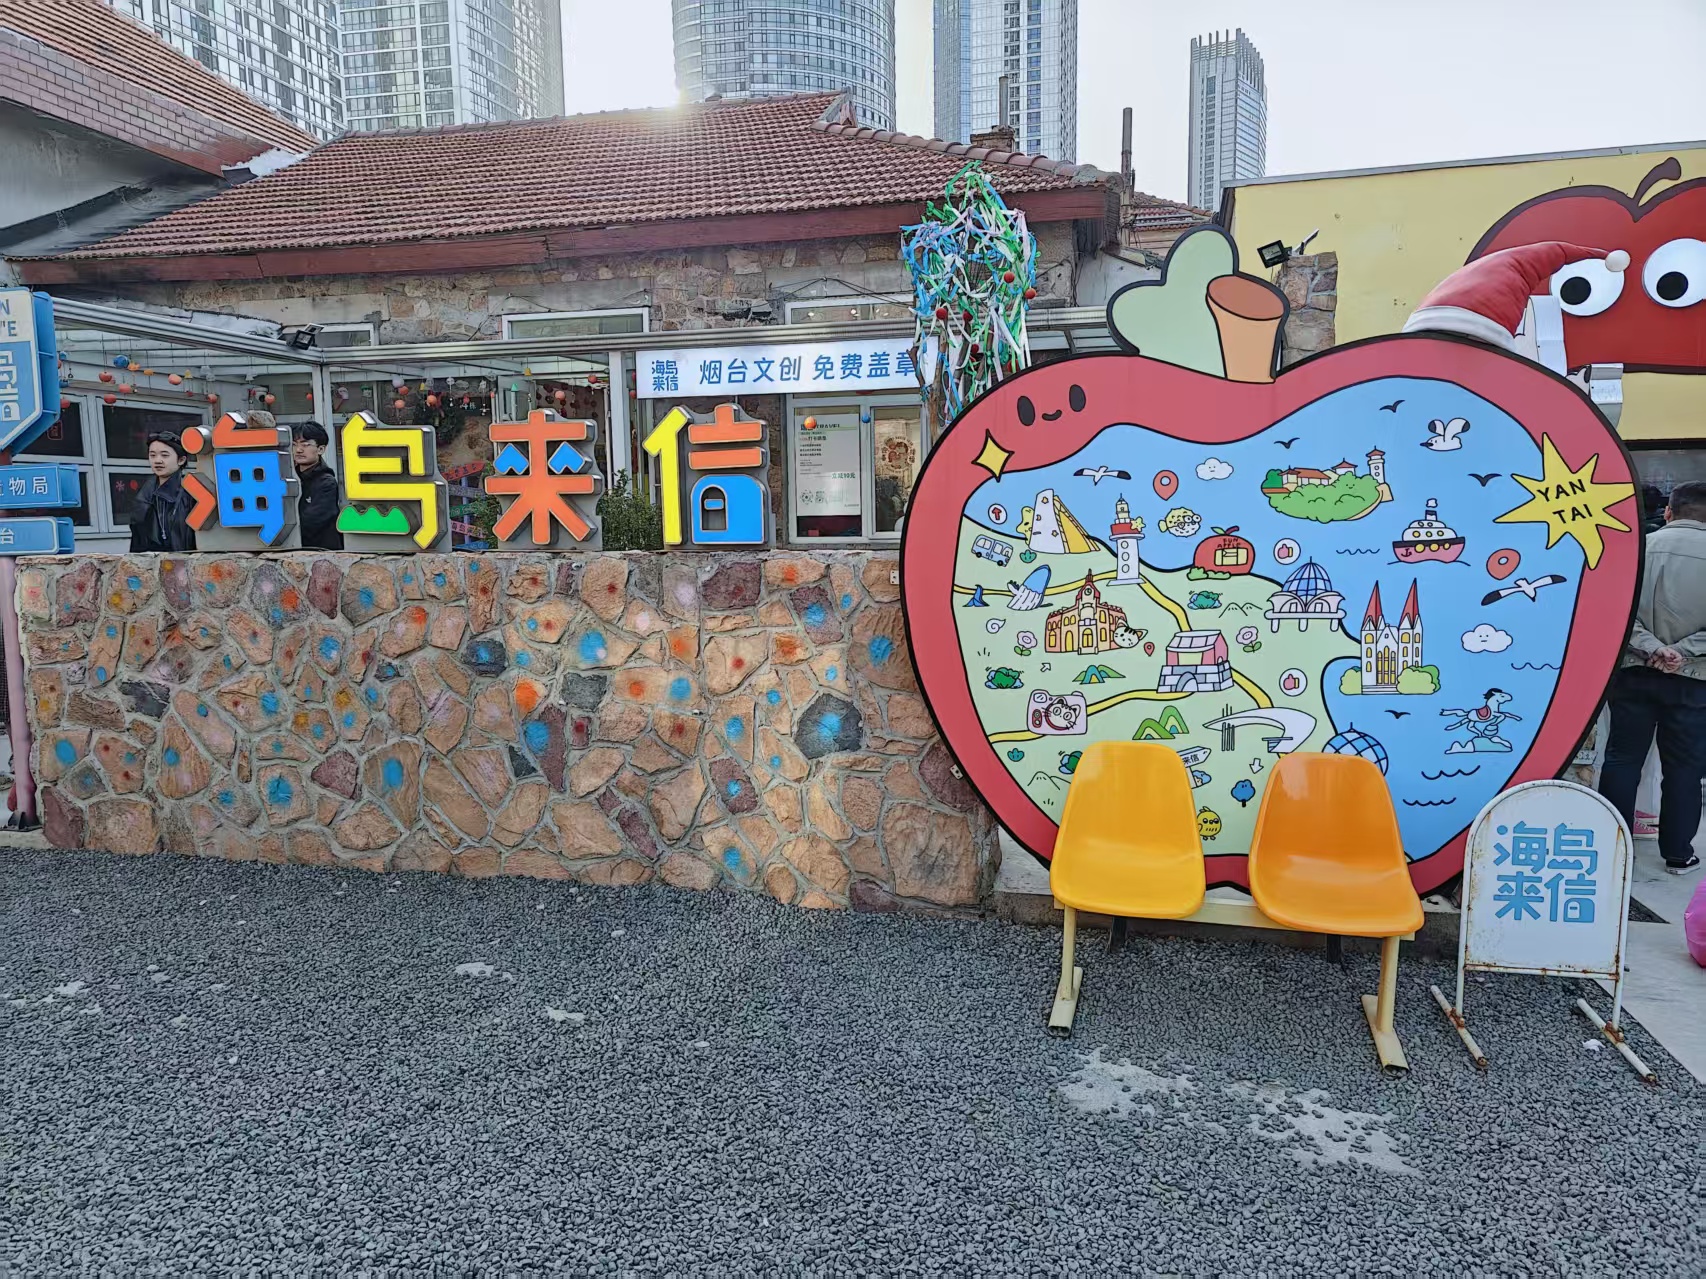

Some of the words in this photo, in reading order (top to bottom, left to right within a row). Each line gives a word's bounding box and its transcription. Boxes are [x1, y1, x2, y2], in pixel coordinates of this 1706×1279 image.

[651, 359, 678, 376] 海岛
[700, 356, 801, 385] 烟台文创
[813, 351, 916, 381] 免费盖章
[652, 374, 679, 391] 来信
[0, 476, 48, 497] 物局
[181, 403, 766, 550] 海岛来信
[1536, 478, 1586, 502] YAN
[1552, 503, 1593, 524] TAI
[1493, 820, 1598, 876] 海岛
[1493, 871, 1597, 923] 来信
